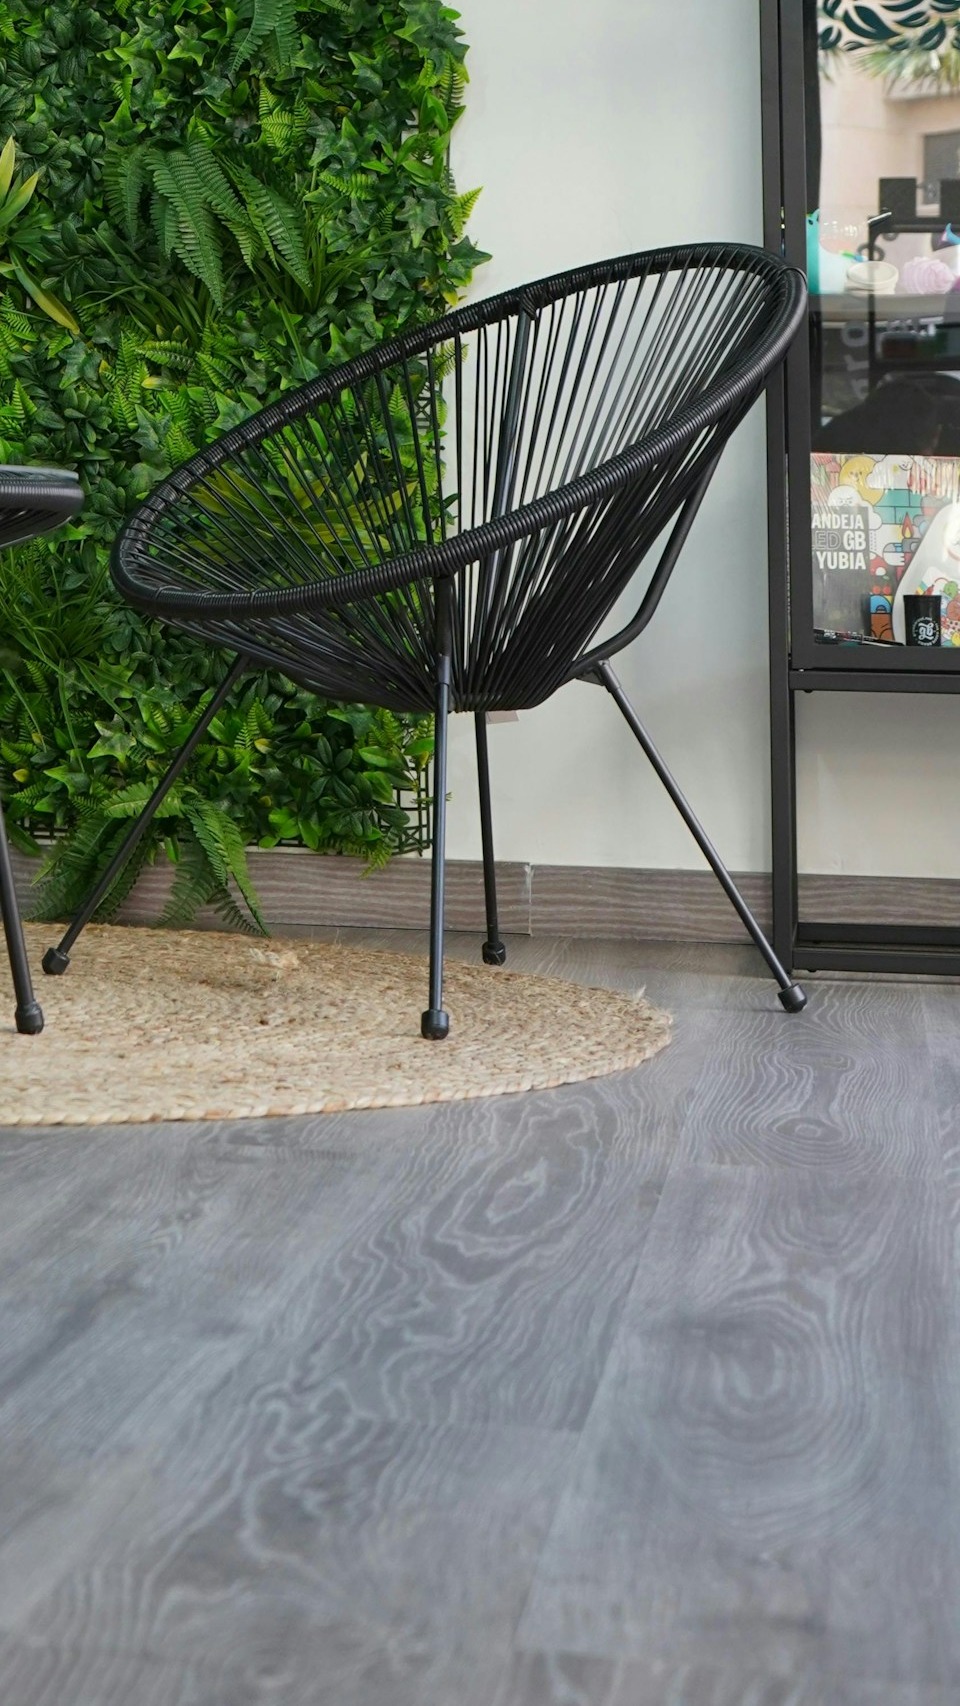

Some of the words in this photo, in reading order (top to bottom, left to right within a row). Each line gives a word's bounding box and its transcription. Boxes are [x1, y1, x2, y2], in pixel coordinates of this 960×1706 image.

[811, 514, 864, 529] ANDEJA
[812, 530, 841, 550] ED
[843, 530, 867, 551] GB
[816, 551, 867, 570] YUBIA
